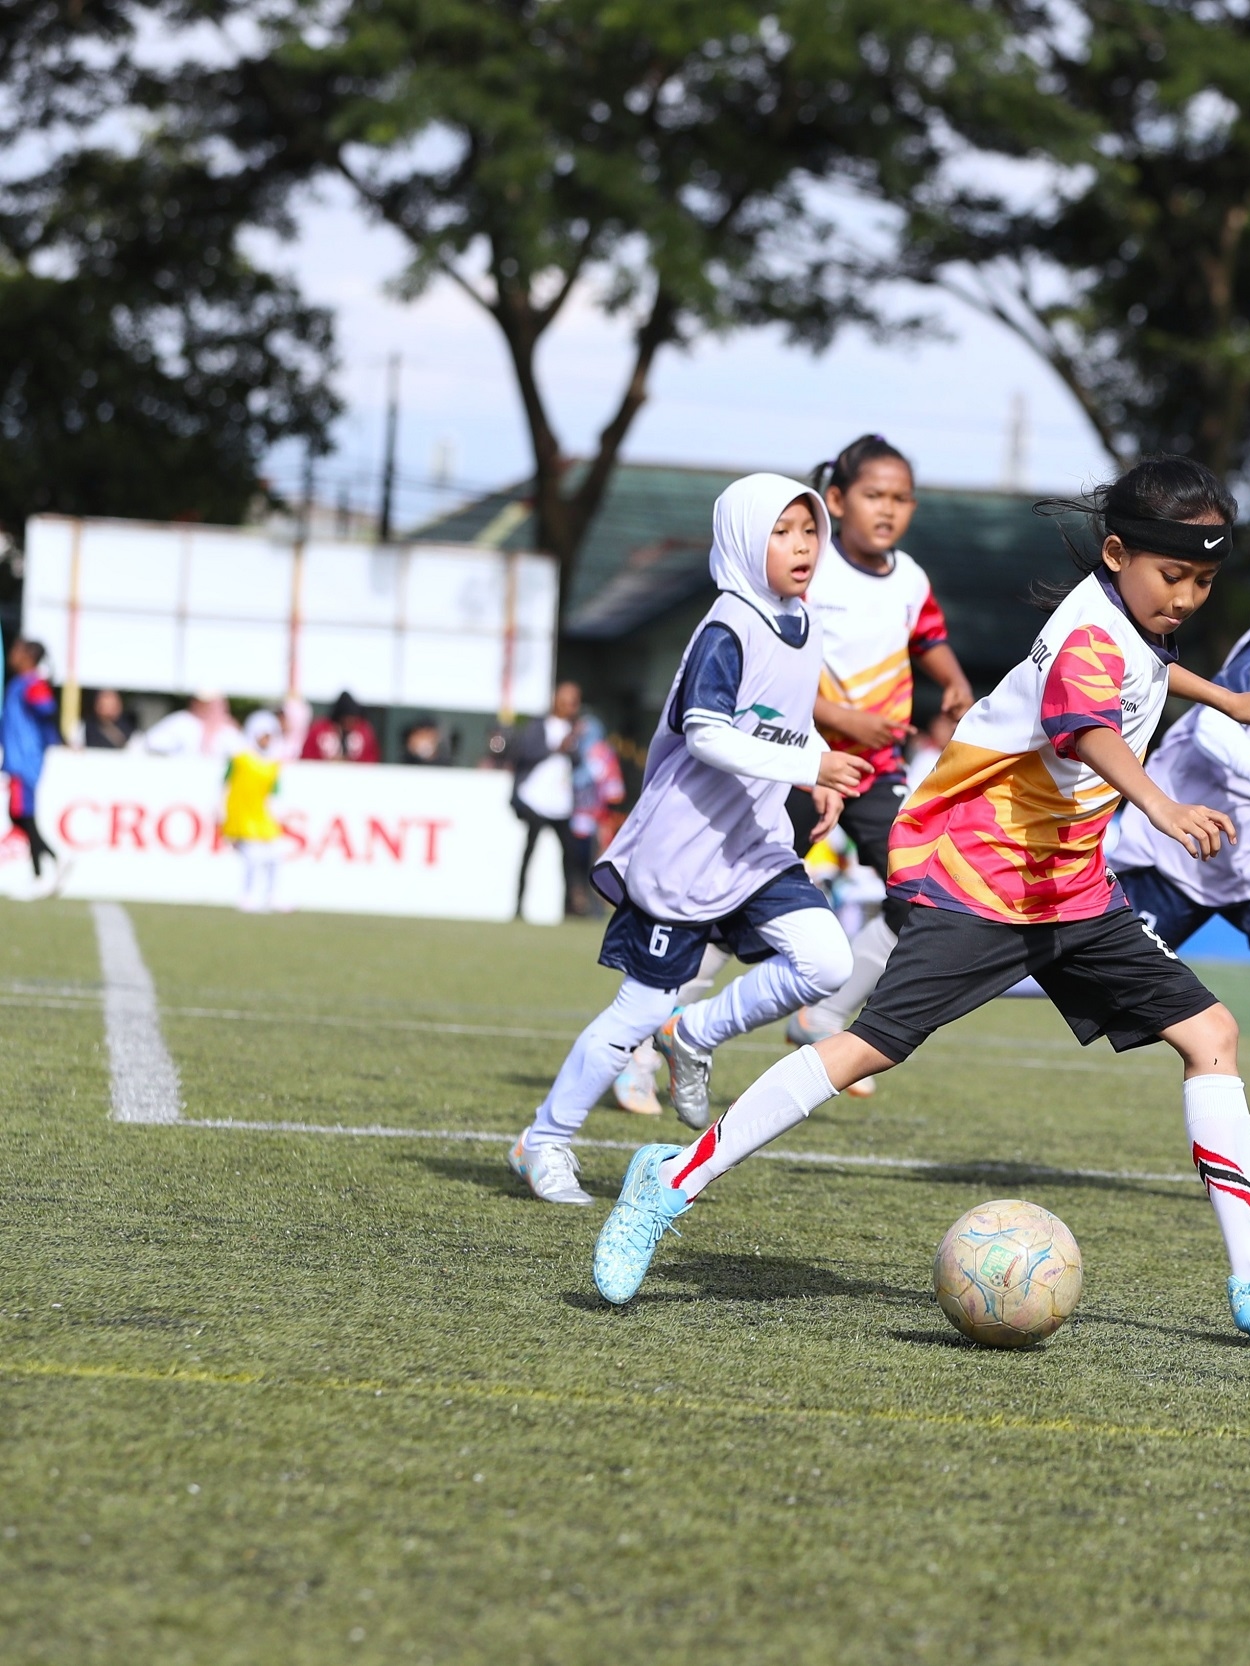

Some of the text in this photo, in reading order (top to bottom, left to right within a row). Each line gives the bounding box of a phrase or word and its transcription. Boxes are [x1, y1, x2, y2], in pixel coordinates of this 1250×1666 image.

[1120, 698, 1140, 713] PION
[57, 797, 453, 866] CROISANT
[648, 923, 673, 958] 6
